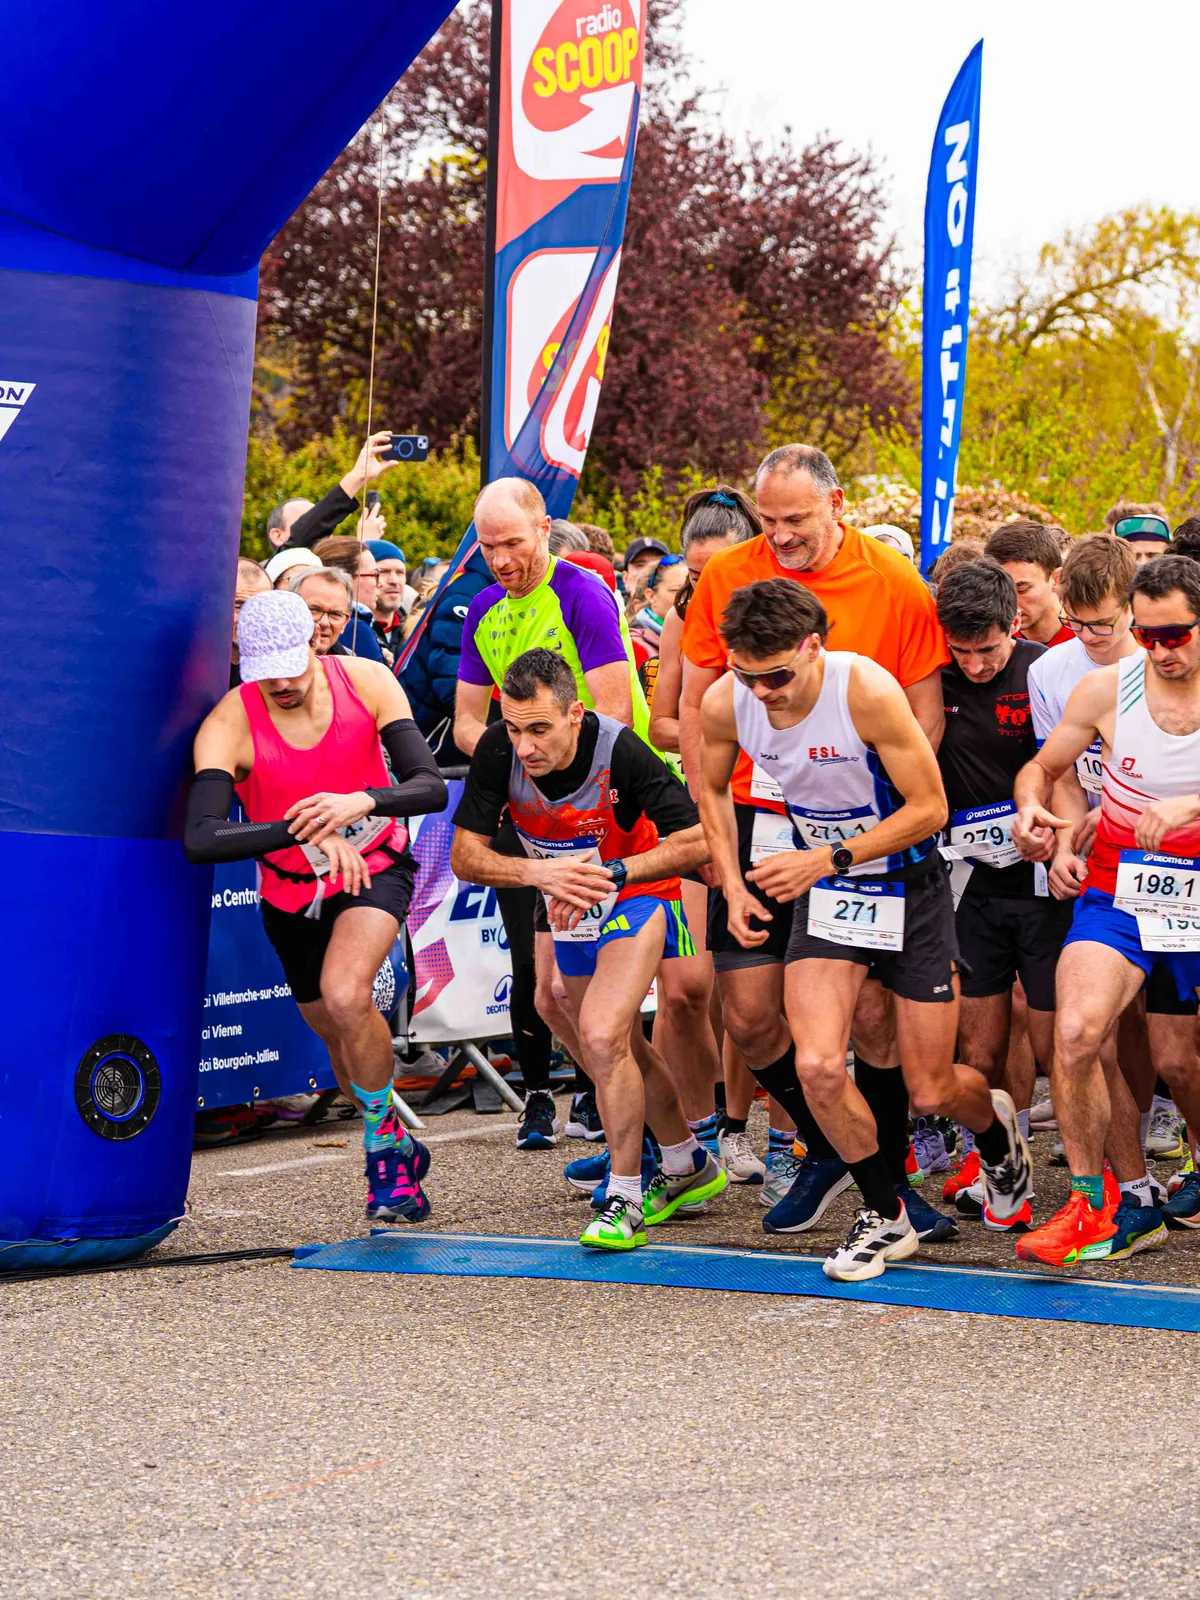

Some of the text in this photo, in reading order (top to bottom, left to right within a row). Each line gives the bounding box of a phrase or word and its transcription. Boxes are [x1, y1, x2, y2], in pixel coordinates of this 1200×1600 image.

[576, 4, 622, 38] radio
[532, 27, 639, 98] SCOOP
[808, 746, 840, 760] ESL
[974, 804, 1011, 818] DECATHLON
[1153, 855, 1194, 866] DECATHLON
[1133, 872, 1195, 898] 198.1
[833, 899, 877, 924] 271
[481, 928, 497, 942] BY
[211, 1024, 243, 1039] Vienne
[212, 1048, 280, 1070] Bourgoin-Jallieu
